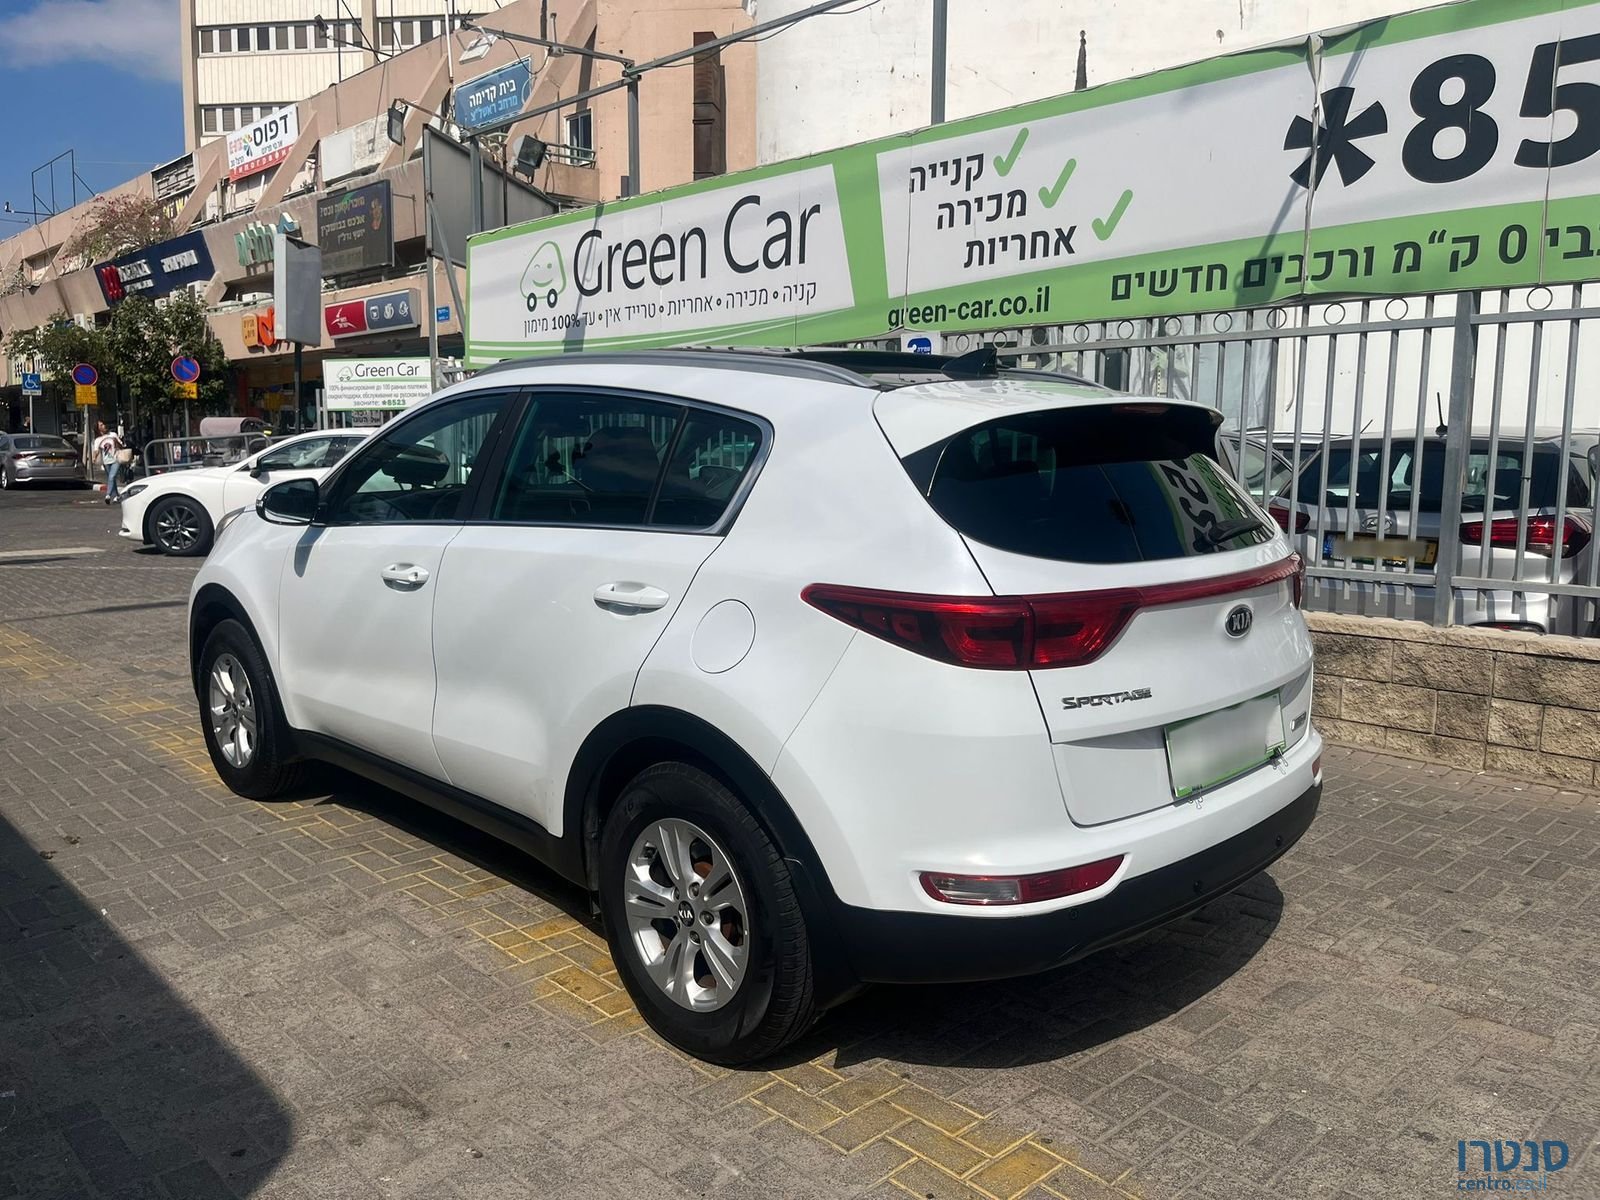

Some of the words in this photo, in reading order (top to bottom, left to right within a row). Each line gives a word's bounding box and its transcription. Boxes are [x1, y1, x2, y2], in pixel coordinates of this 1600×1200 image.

[500, 80, 516, 96] בית
[498, 96, 518, 111] מרחב
[253, 114, 288, 147] דפוס
[910, 153, 984, 193] קנייה
[937, 189, 1027, 230] מכירה
[573, 226, 707, 297] Green
[723, 194, 821, 274] Car
[964, 225, 1077, 268] אחריות
[1500, 224, 1528, 264] 0
[1545, 225, 1600, 260] בי
[1243, 246, 1375, 288] ורכבים
[1112, 263, 1228, 301] חדשים
[726, 288, 768, 309] מכירה
[783, 282, 816, 306] קניה
[625, 303, 656, 320] טרייד
[667, 296, 712, 316] אחריות
[888, 285, 1050, 330] green-car.co.il
[524, 317, 548, 338] מימון
[552, 314, 580, 331] 100%
[582, 312, 596, 326] עד
[606, 308, 621, 328] אין
[354, 364, 394, 377] Green
[398, 362, 420, 376] Car
[1062, 688, 1152, 710] SPORTAGE
[678, 910, 693, 918] KIA
